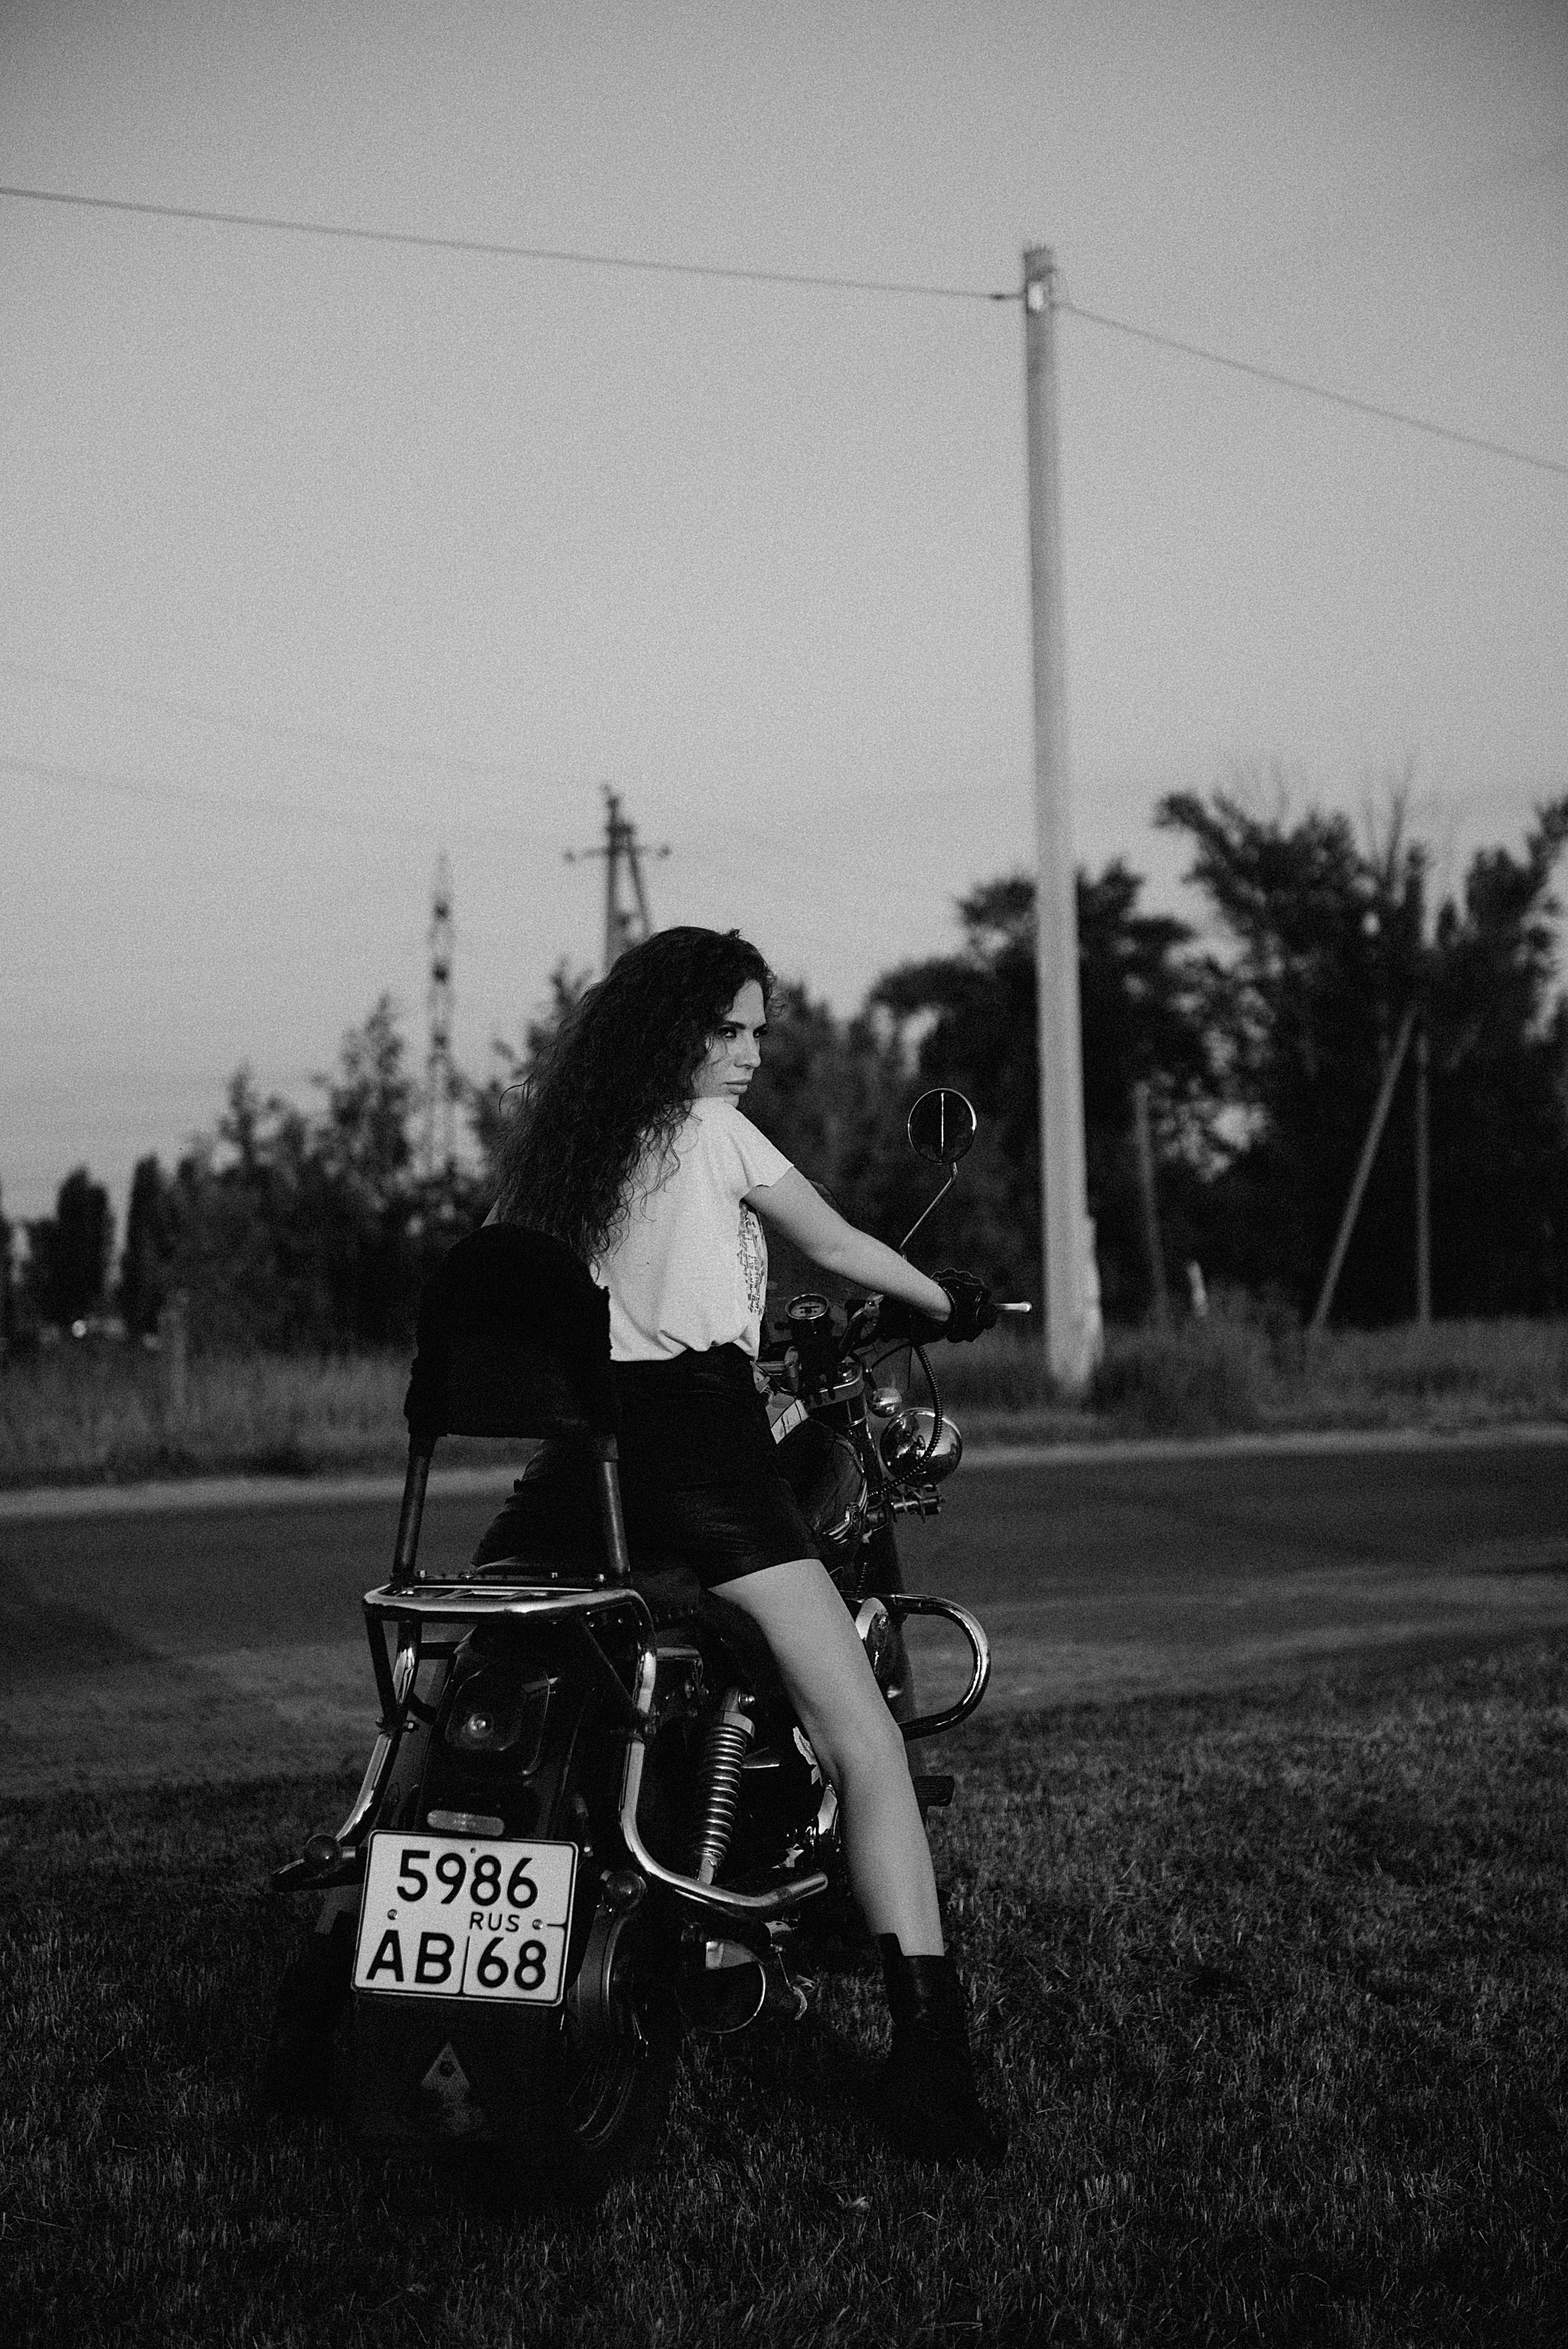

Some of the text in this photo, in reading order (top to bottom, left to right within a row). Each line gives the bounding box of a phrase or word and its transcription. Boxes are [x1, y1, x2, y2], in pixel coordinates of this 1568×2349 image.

[396, 1849, 538, 1909] 5986
[469, 1911, 521, 1933] RUS
[366, 1929, 548, 1991] AB 68
